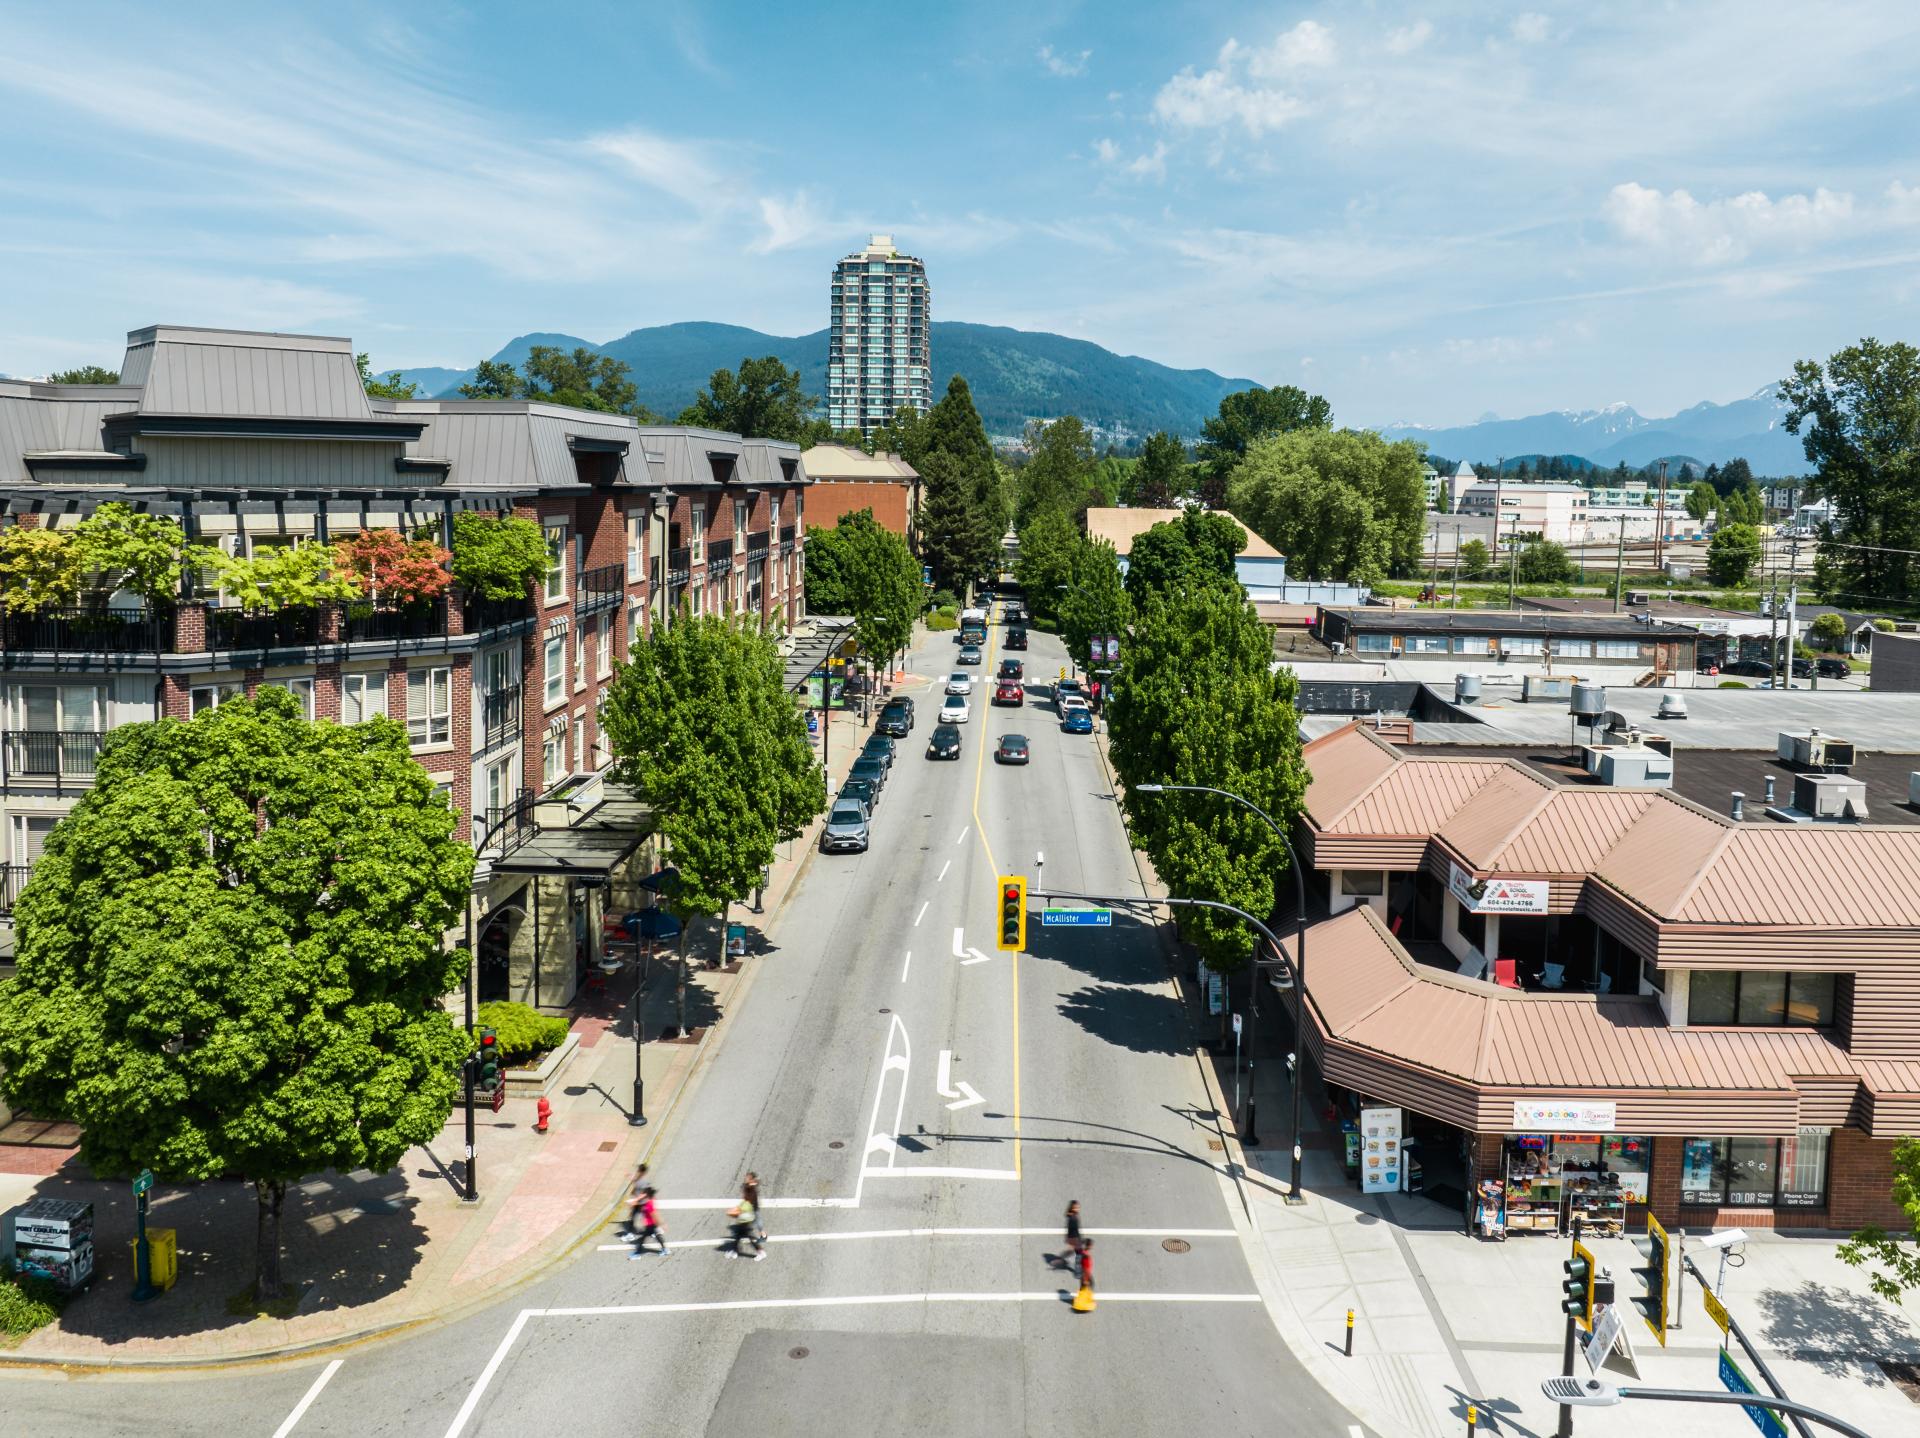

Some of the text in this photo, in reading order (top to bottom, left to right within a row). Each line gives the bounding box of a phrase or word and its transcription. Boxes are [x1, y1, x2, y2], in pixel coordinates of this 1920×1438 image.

[1046, 914, 1109, 923] McAllister Ave
[1699, 1191, 1721, 1199] Pick-up
[1730, 1192, 1755, 1204] COLOR
[33, 1226, 69, 1235] COQUITLAM
[1721, 1363, 1766, 1432] Shauessy
